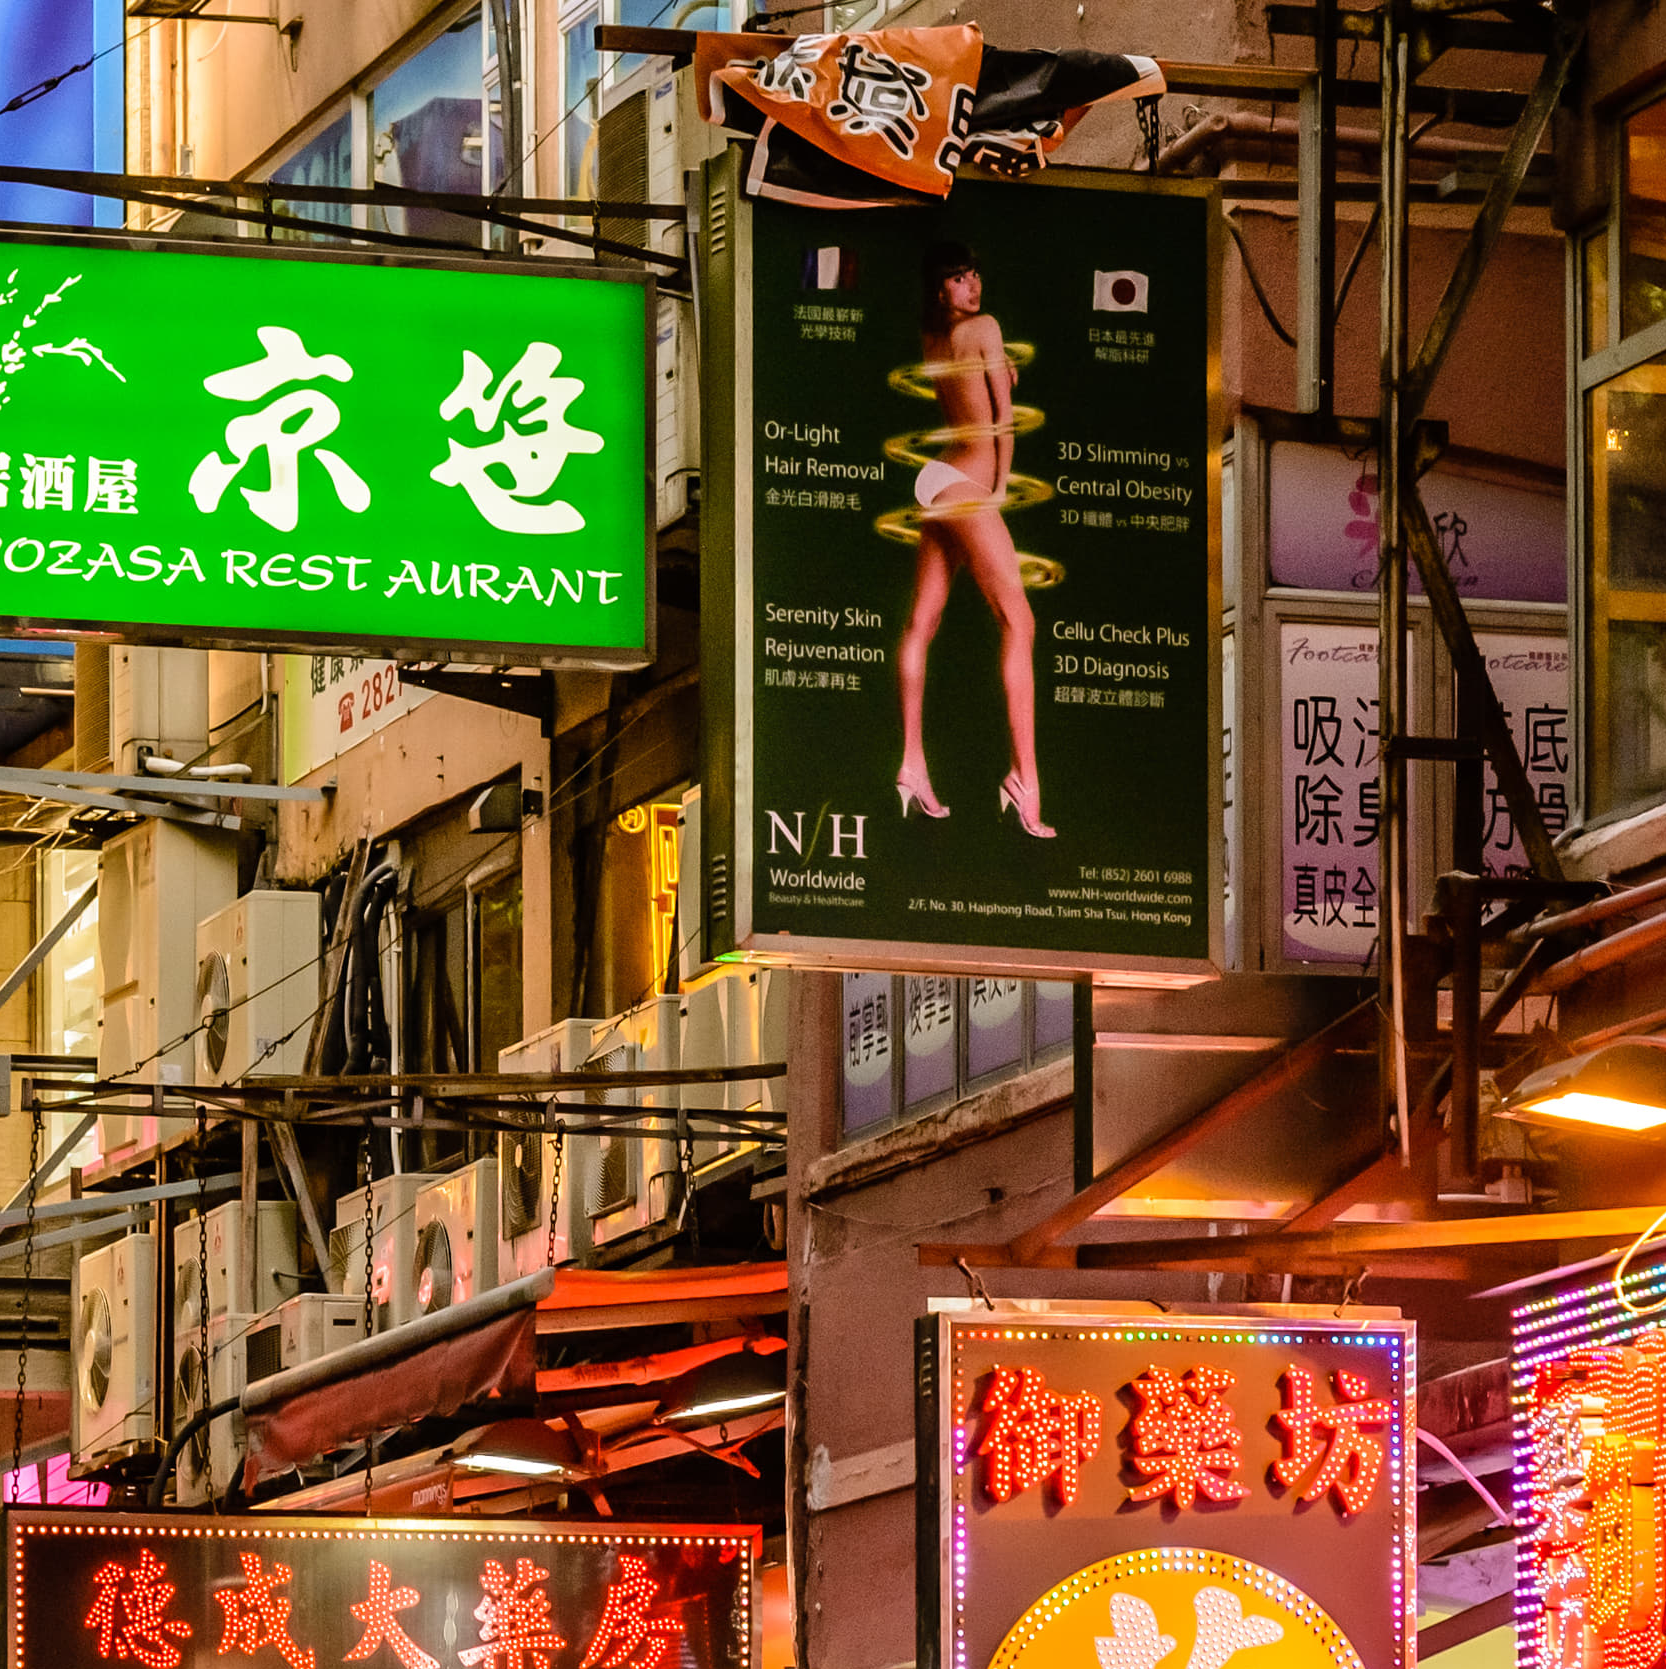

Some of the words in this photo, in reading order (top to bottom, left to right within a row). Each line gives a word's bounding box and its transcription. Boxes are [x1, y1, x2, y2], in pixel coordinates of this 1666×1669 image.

[765, 421, 840, 446] Or-Light
[765, 456, 801, 475] Hair
[807, 458, 884, 481] Removal
[1058, 441, 1081, 461] 3D
[1087, 445, 1171, 471] Slimming
[1056, 477, 1120, 498] Central
[1126, 480, 1192, 506] Obesity
[766, 603, 839, 630] Serenity
[845, 608, 882, 628] Skin
[1053, 622, 1094, 643] Cellu
[1100, 624, 1151, 645] Check
[1157, 627, 1190, 647] Plus
[765, 638, 885, 663] Rejuvenation
[1054, 655, 1079, 674] 3D
[1084, 657, 1169, 682] Diagnosis
[770, 868, 865, 892] Worldwide
[1079, 867, 1098, 881] Tel:
[1101, 869, 1130, 883] (852)
[1134, 869, 1160, 882] 2601
[1164, 872, 1192, 884] 6988
[1048, 886, 1192, 904] www.NH-worldwide.com
[969, 902, 1022, 917] Haiphong
[1057, 906, 1081, 917] Tsim
[1084, 908, 1103, 919] Sha
[1131, 910, 1160, 923] Hong
[1163, 911, 1191, 926] Kong
[980, 1363, 1393, 1516] 御藥坊
